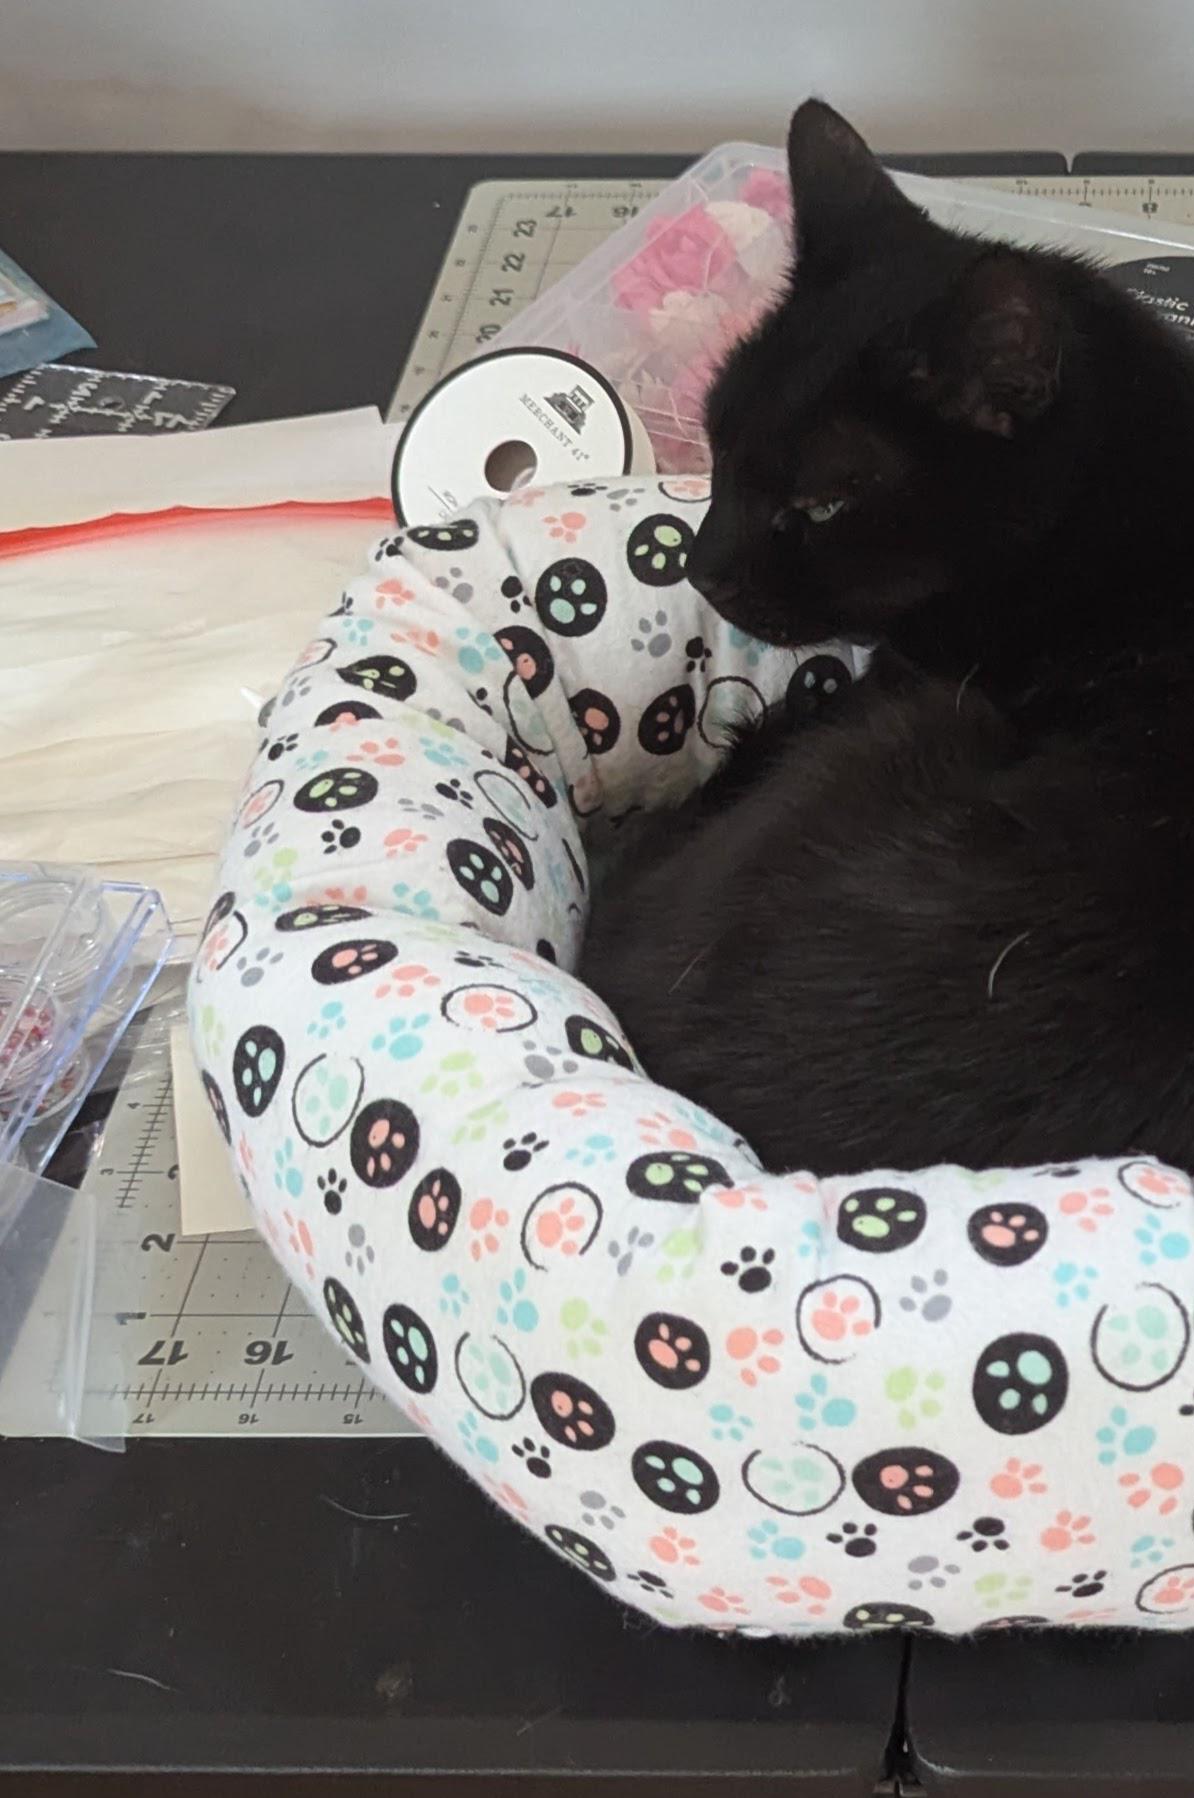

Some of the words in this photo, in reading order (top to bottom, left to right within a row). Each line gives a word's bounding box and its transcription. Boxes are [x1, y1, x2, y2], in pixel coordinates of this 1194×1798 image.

[513, 219, 538, 238] 23
[501, 253, 526, 273] 22
[489, 288, 514, 306] 21
[518, 393, 573, 448] MERCHANT
[127, 1101, 141, 1109] 4
[100, 1168, 114, 1176] 3
[141, 1233, 176, 1253] 2
[115, 1312, 147, 1325] 1
[138, 1340, 188, 1366] 17
[244, 1340, 294, 1366] 16
[132, 1413, 155, 1424] 17
[238, 1413, 260, 1425] 16
[342, 1413, 364, 1425] 15
